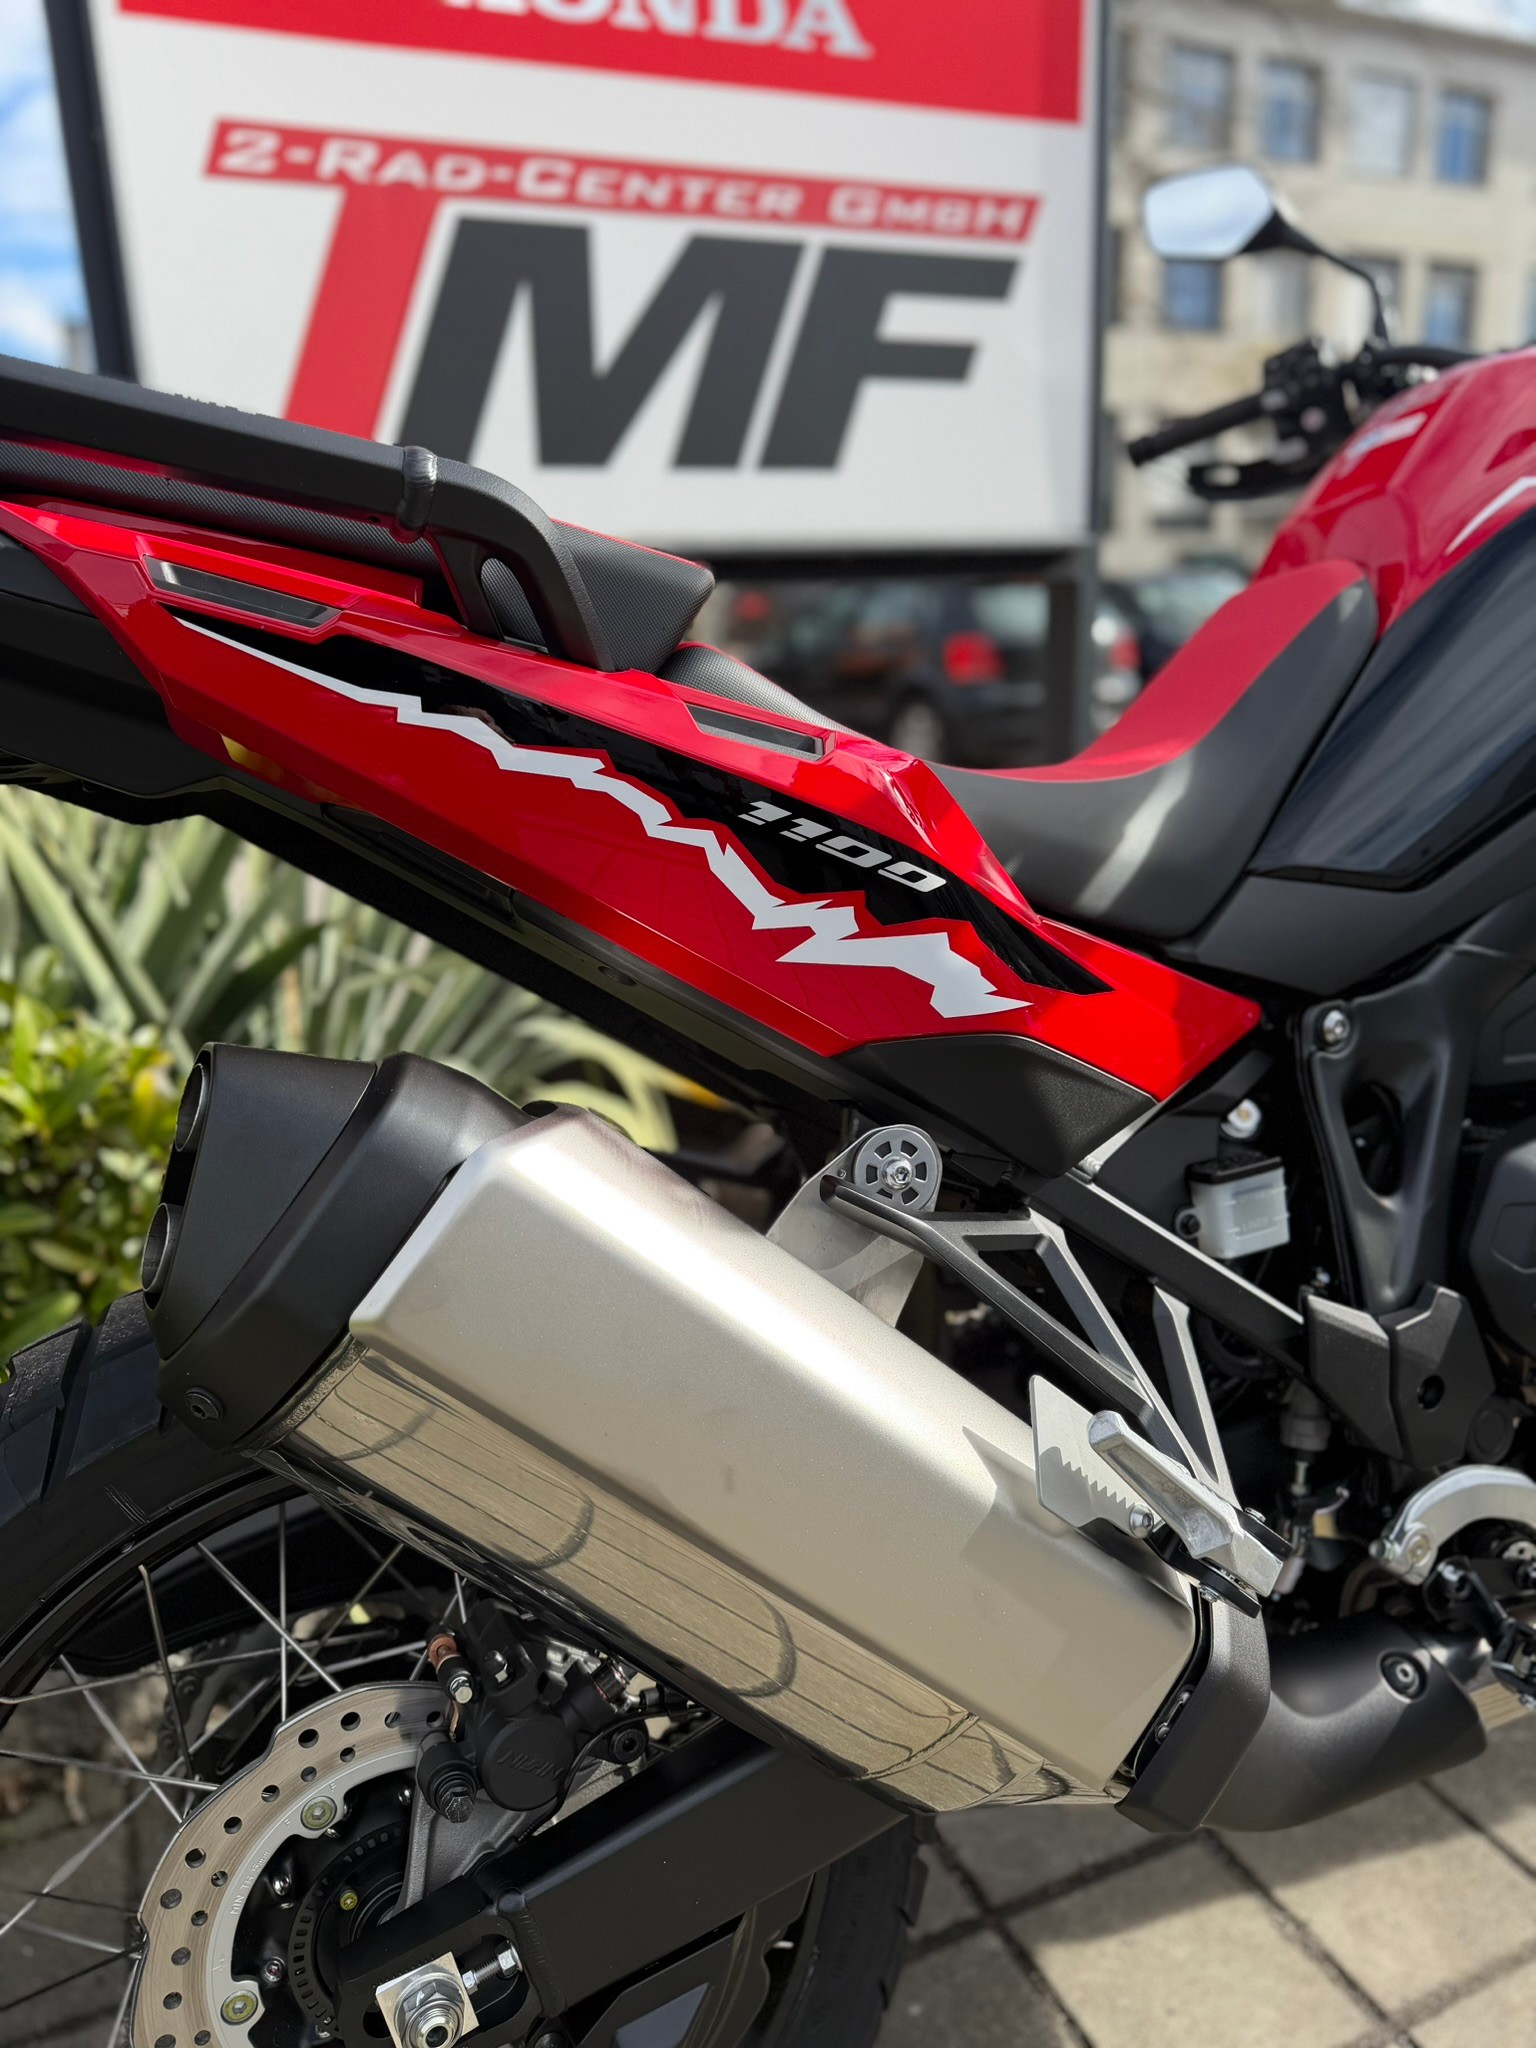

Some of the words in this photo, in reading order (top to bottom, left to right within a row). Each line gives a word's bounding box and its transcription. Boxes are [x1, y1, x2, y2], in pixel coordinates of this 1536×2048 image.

[203, 119, 1021, 471] TMF
[738, 800, 947, 892] 1100
[229, 1894, 245, 1915] MIN
